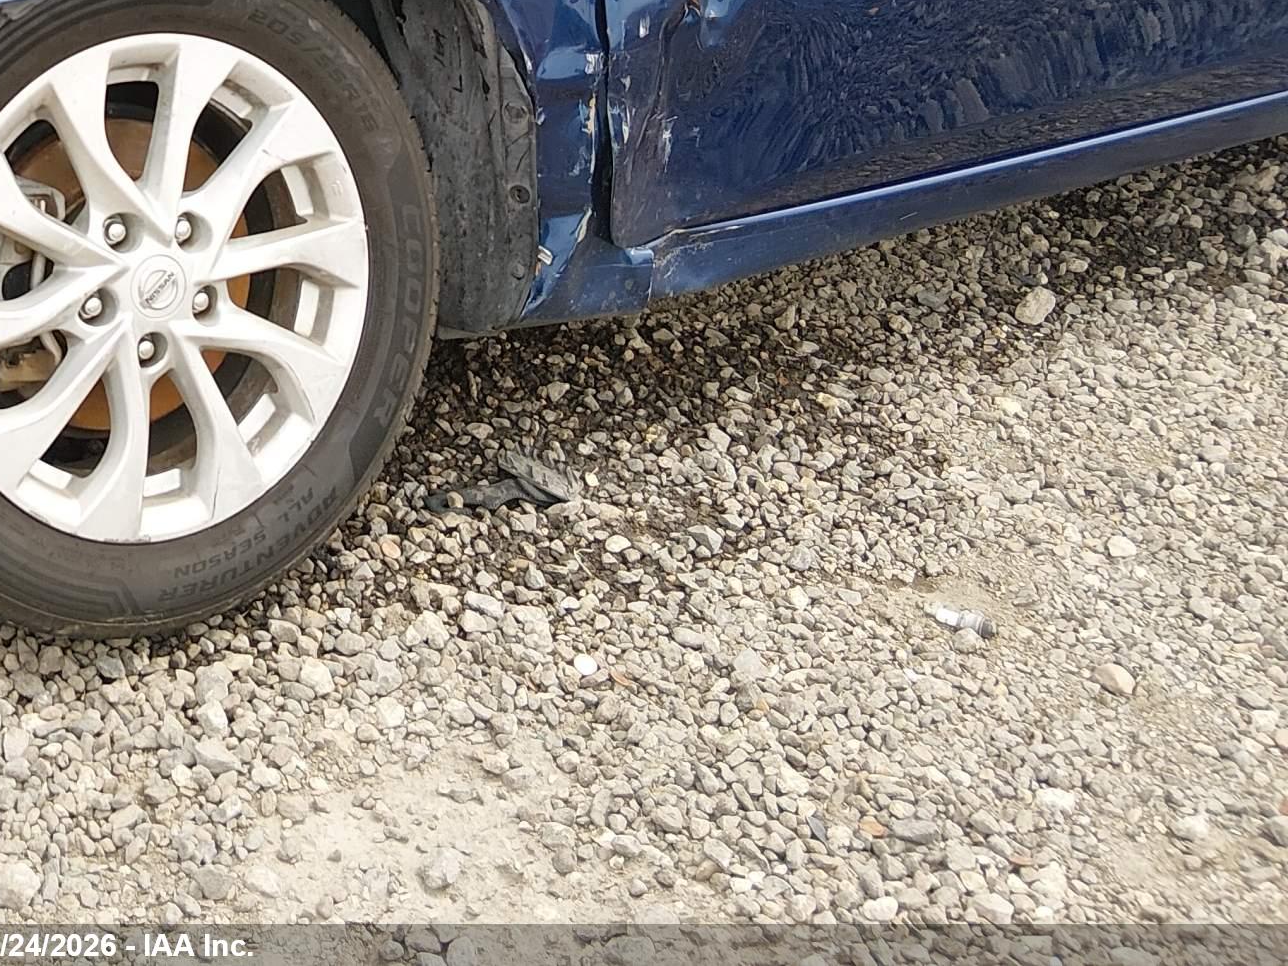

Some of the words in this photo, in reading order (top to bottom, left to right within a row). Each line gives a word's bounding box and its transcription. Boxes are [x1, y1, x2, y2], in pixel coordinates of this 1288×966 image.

[374, 204, 424, 428] COOPER
[157, 485, 338, 602] ADVENTURER
[278, 487, 314, 523] ALL
[173, 529, 267, 580] SEASON
